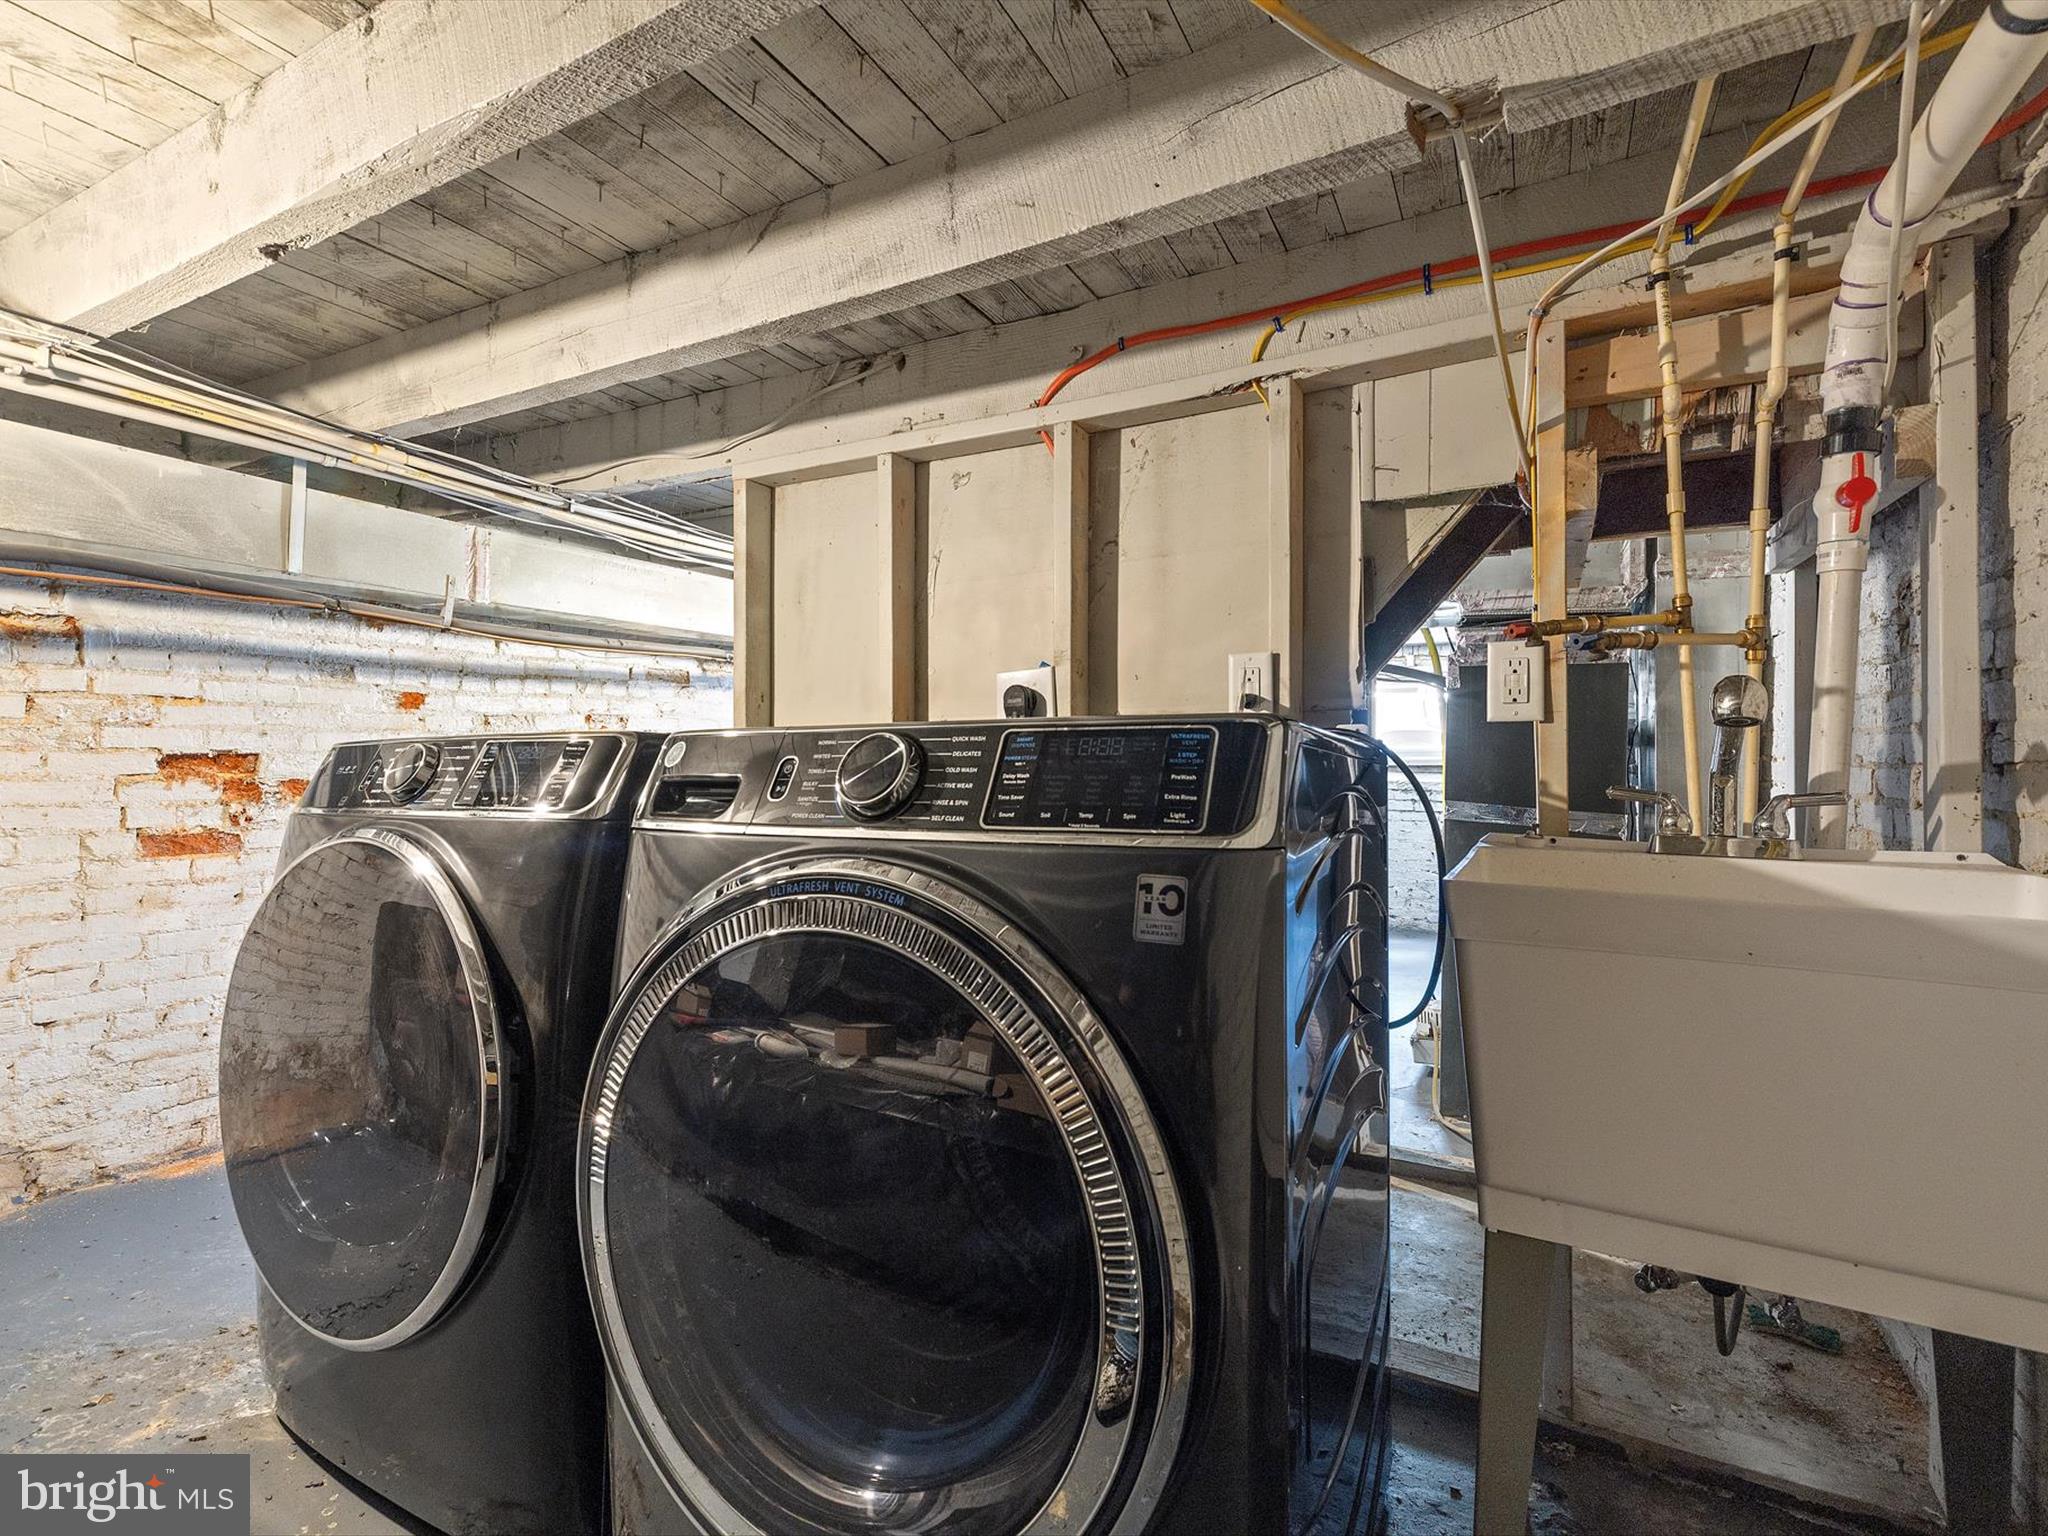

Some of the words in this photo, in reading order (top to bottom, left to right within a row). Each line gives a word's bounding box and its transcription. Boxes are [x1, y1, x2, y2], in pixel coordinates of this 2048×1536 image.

[769, 880, 830, 897] ULTRAFRESH
[834, 881, 860, 894] VENT
[864, 885, 906, 906] SYSTEM
[1139, 883, 1185, 916] 10
